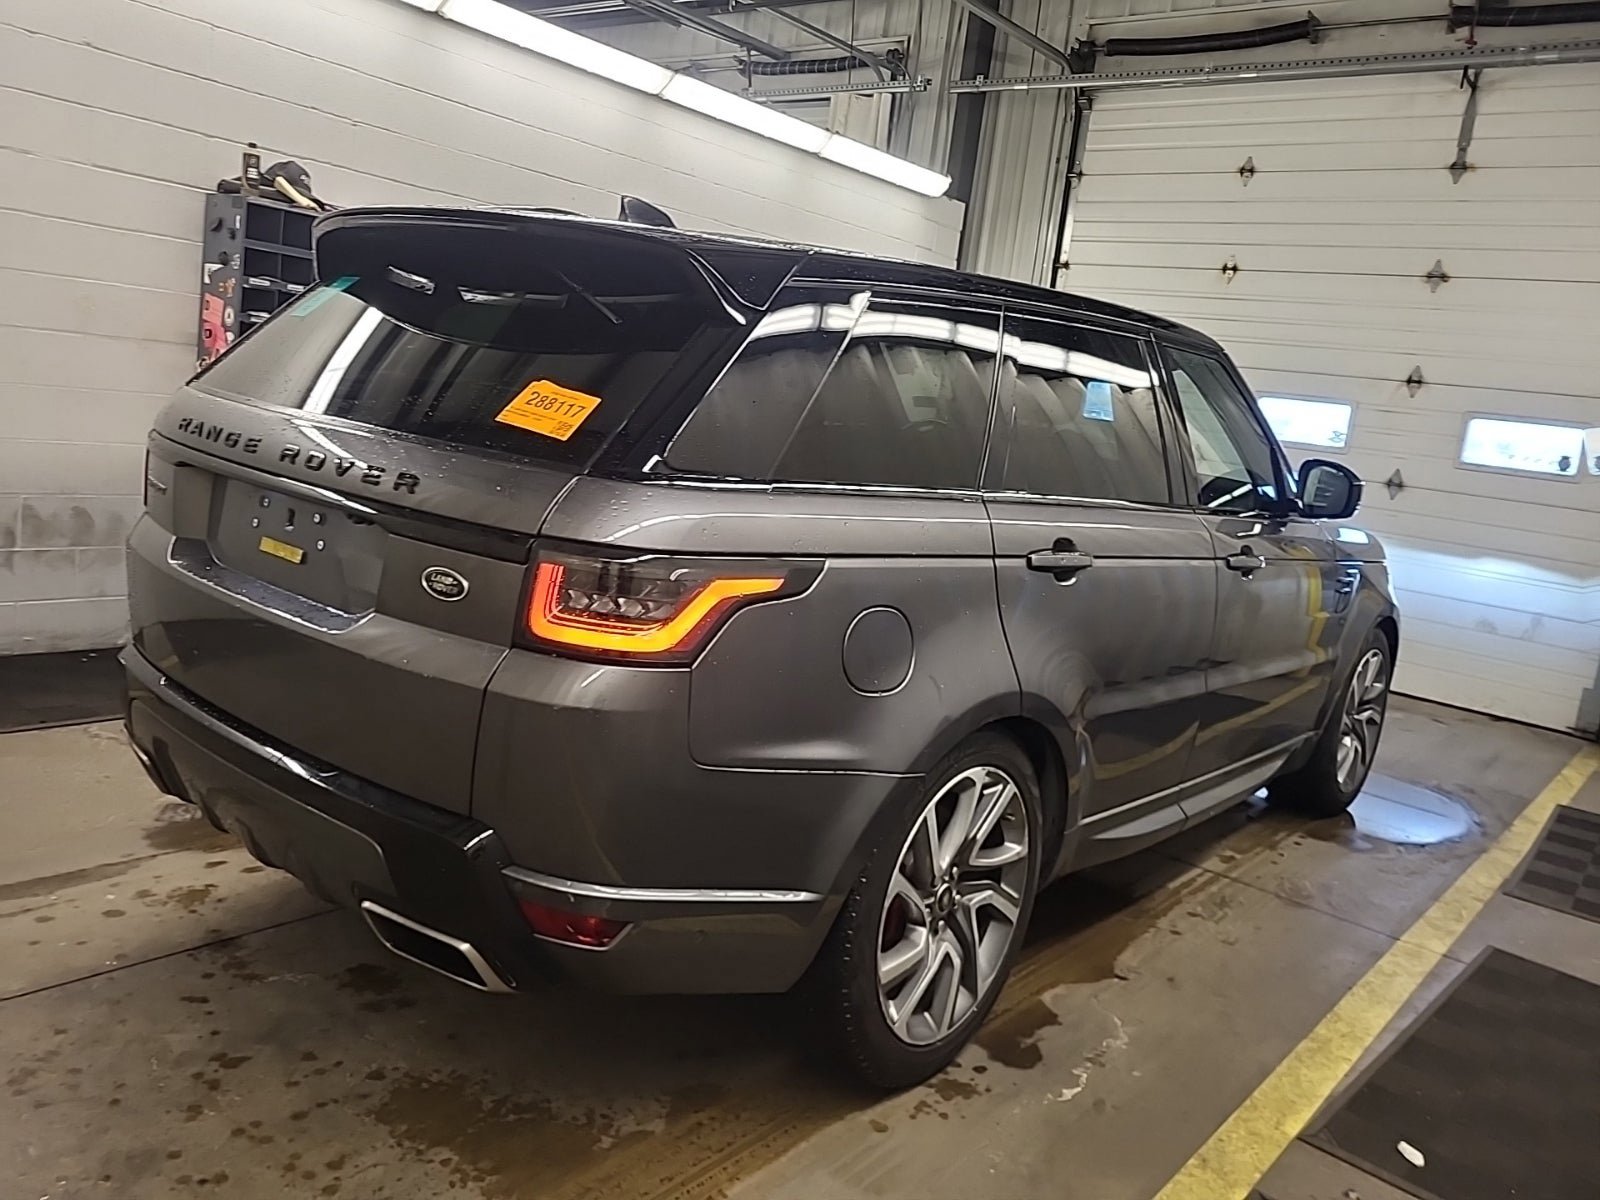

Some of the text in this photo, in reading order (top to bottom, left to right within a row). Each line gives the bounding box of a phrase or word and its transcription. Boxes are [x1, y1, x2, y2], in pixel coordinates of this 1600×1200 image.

[525, 390, 587, 418] 288117
[178, 418, 421, 494] RANGE ROVER
